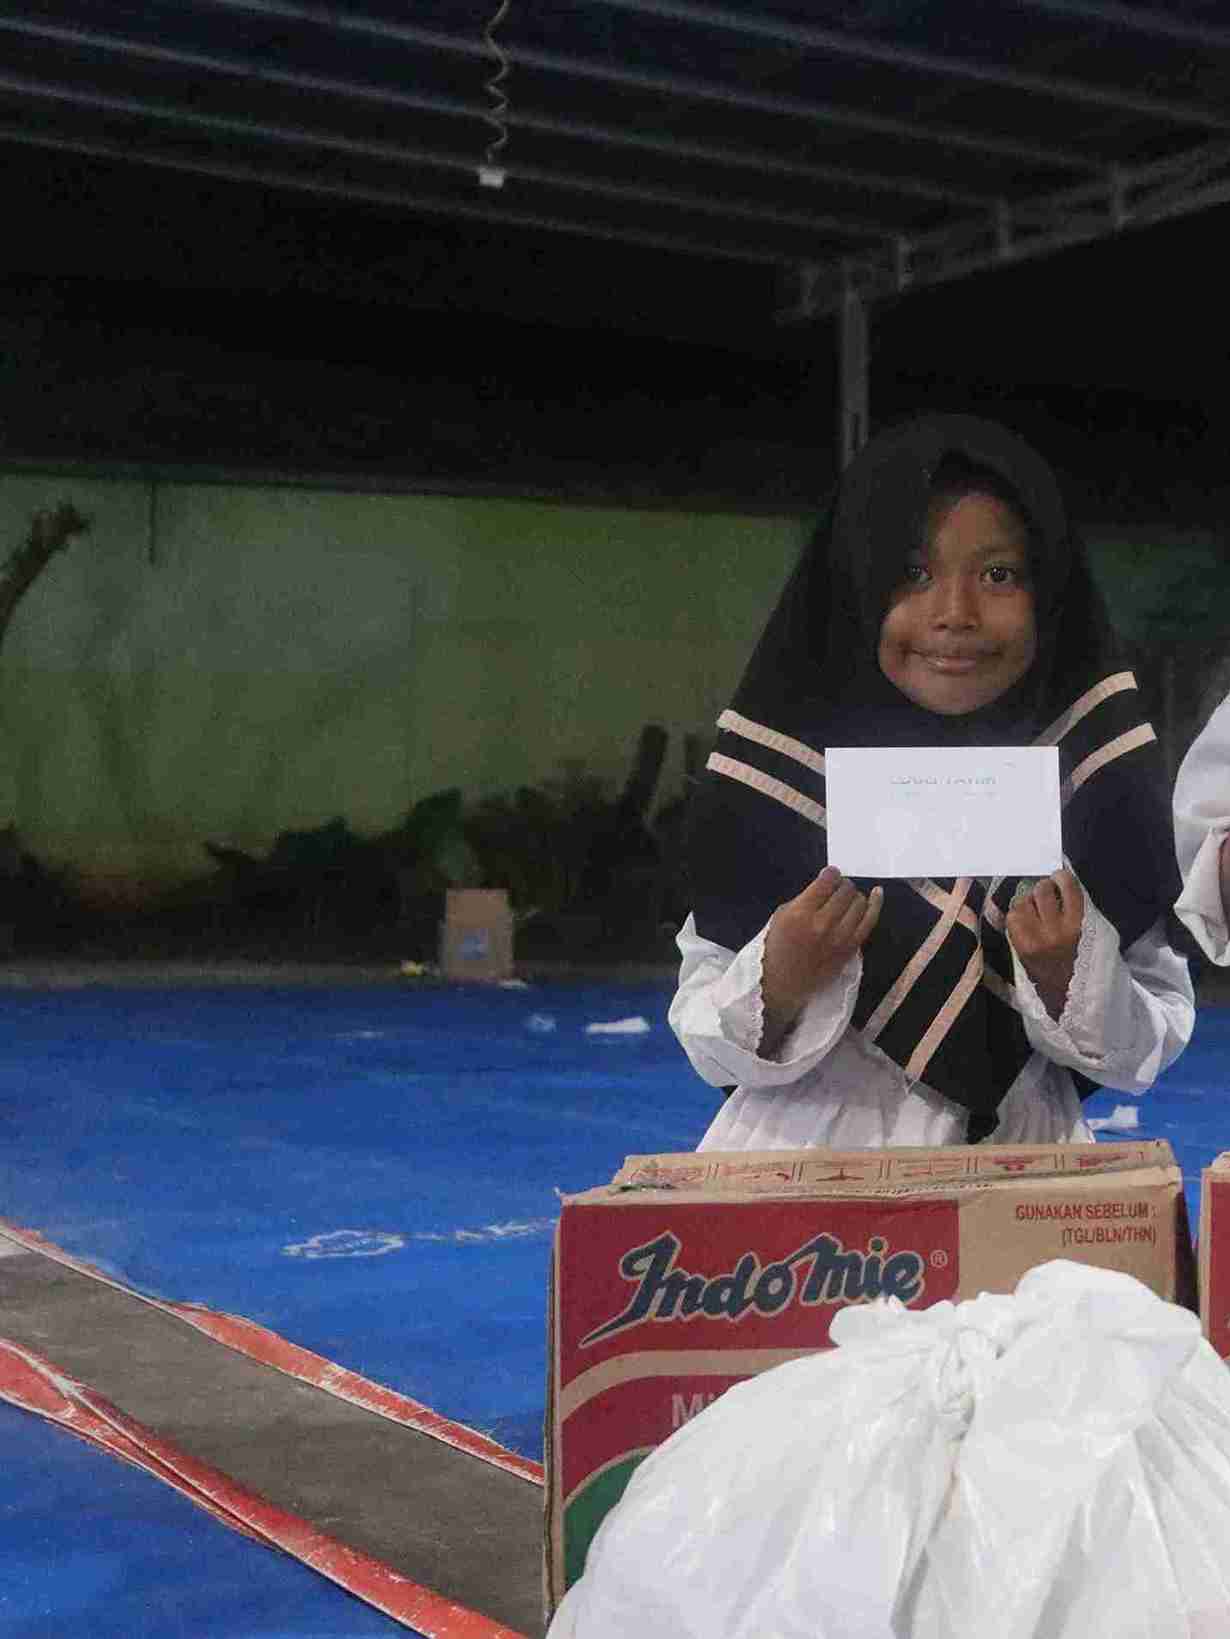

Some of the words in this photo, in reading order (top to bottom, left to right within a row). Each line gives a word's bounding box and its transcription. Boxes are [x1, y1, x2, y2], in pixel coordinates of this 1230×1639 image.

[1016, 1203, 1081, 1221] GUNAKAN
[1086, 1201, 1148, 1220] SEBELUM
[672, 1393, 715, 1428] M
